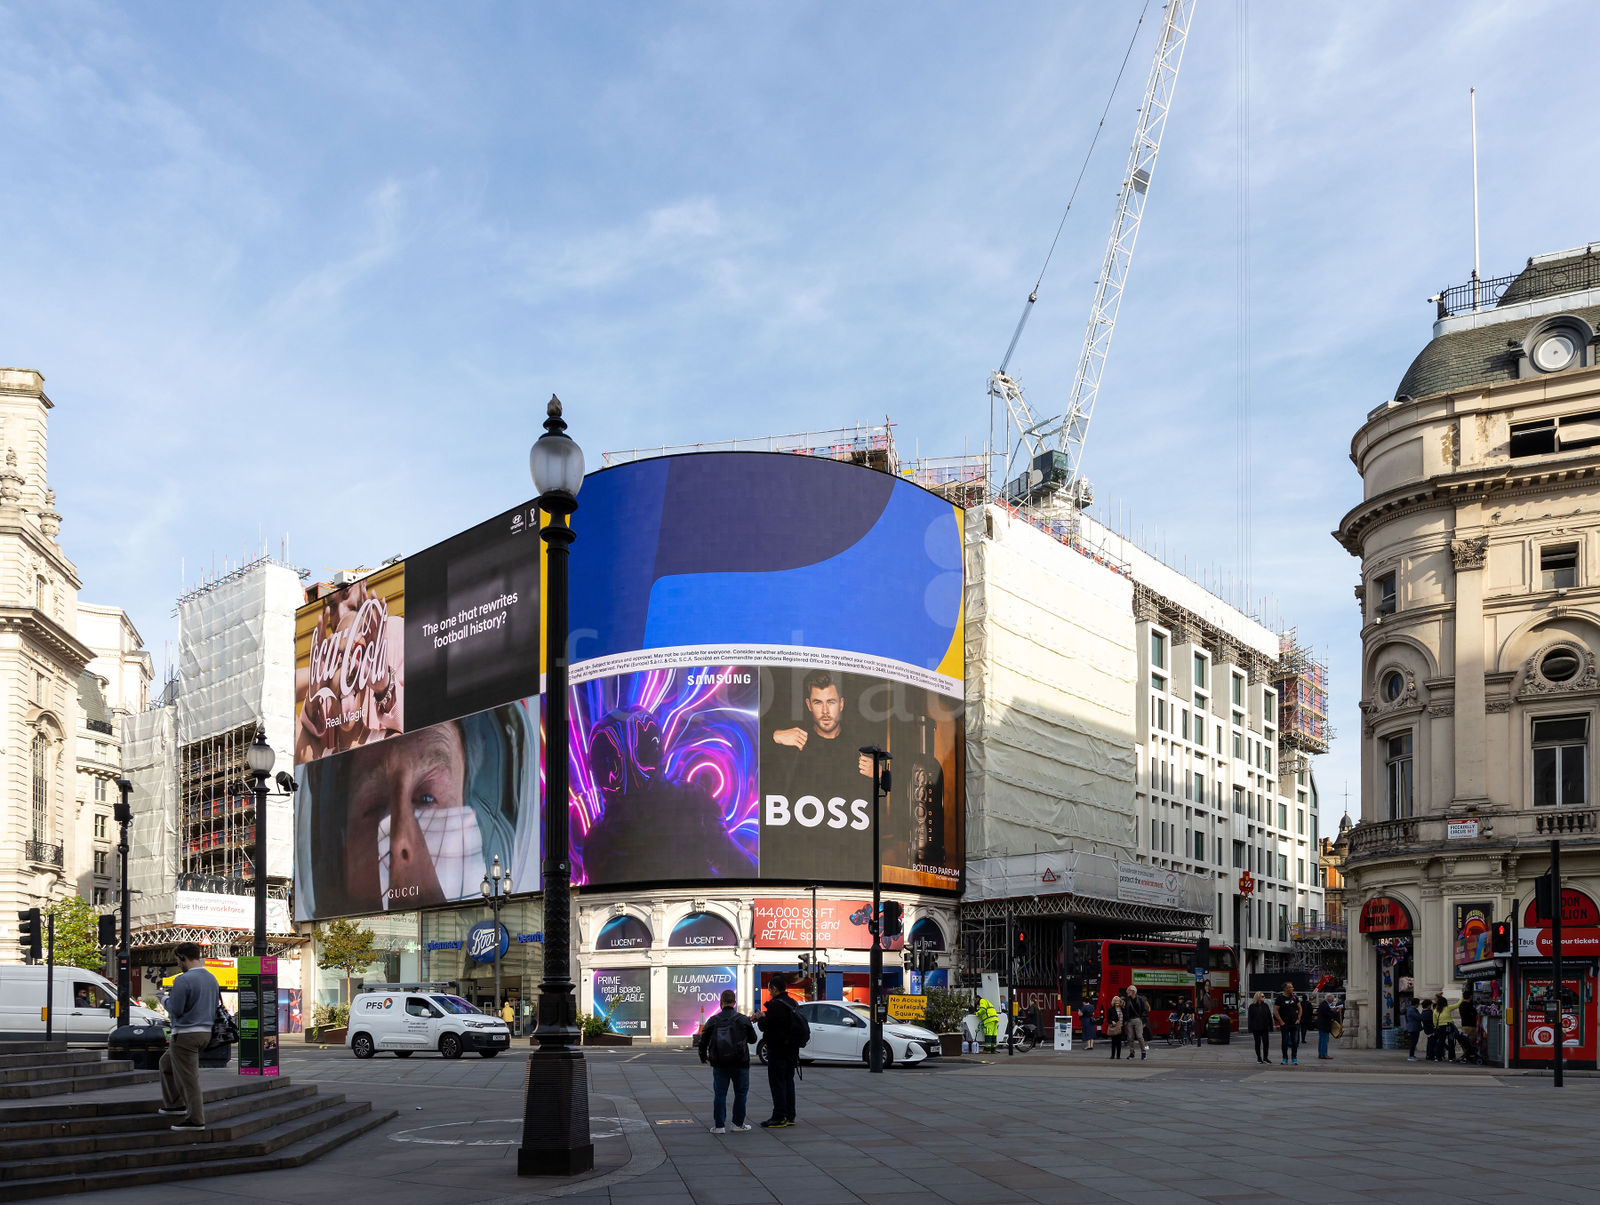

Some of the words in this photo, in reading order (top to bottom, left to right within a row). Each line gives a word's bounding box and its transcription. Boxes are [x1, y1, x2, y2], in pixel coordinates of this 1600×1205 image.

[422, 623, 439, 637] The
[440, 616, 457, 631] one
[458, 606, 478, 624] that
[479, 592, 518, 616] rewrites
[433, 625, 468, 649] football
[469, 611, 507, 636] history?
[688, 674, 751, 686] SAMSUNG
[325, 717, 342, 729] Real
[343, 707, 366, 723] Magic
[765, 794, 870, 831] BOSS
[912, 863, 938, 874] BOTTLED
[938, 866, 960, 877] PARFUM
[388, 885, 420, 899] GUCCI
[210, 906, 245, 914] workforce
[755, 907, 799, 918] 144,000
[821, 908, 834, 918] FT
[767, 919, 777, 929] of
[821, 920, 840, 930] and
[761, 930, 798, 940] RETAIL
[611, 938, 637, 947] LUCENT
[685, 936, 716, 945] LUCENT
[1574, 937, 1599, 945] tickets
[598, 976, 621, 985] PRIME
[672, 974, 732, 984] ILLUMINATED
[602, 985, 618, 994] retail
[619, 986, 641, 994] space
[678, 984, 689, 995] by
[697, 992, 721, 1002] ICON
[366, 1002, 383, 1010] PFS
